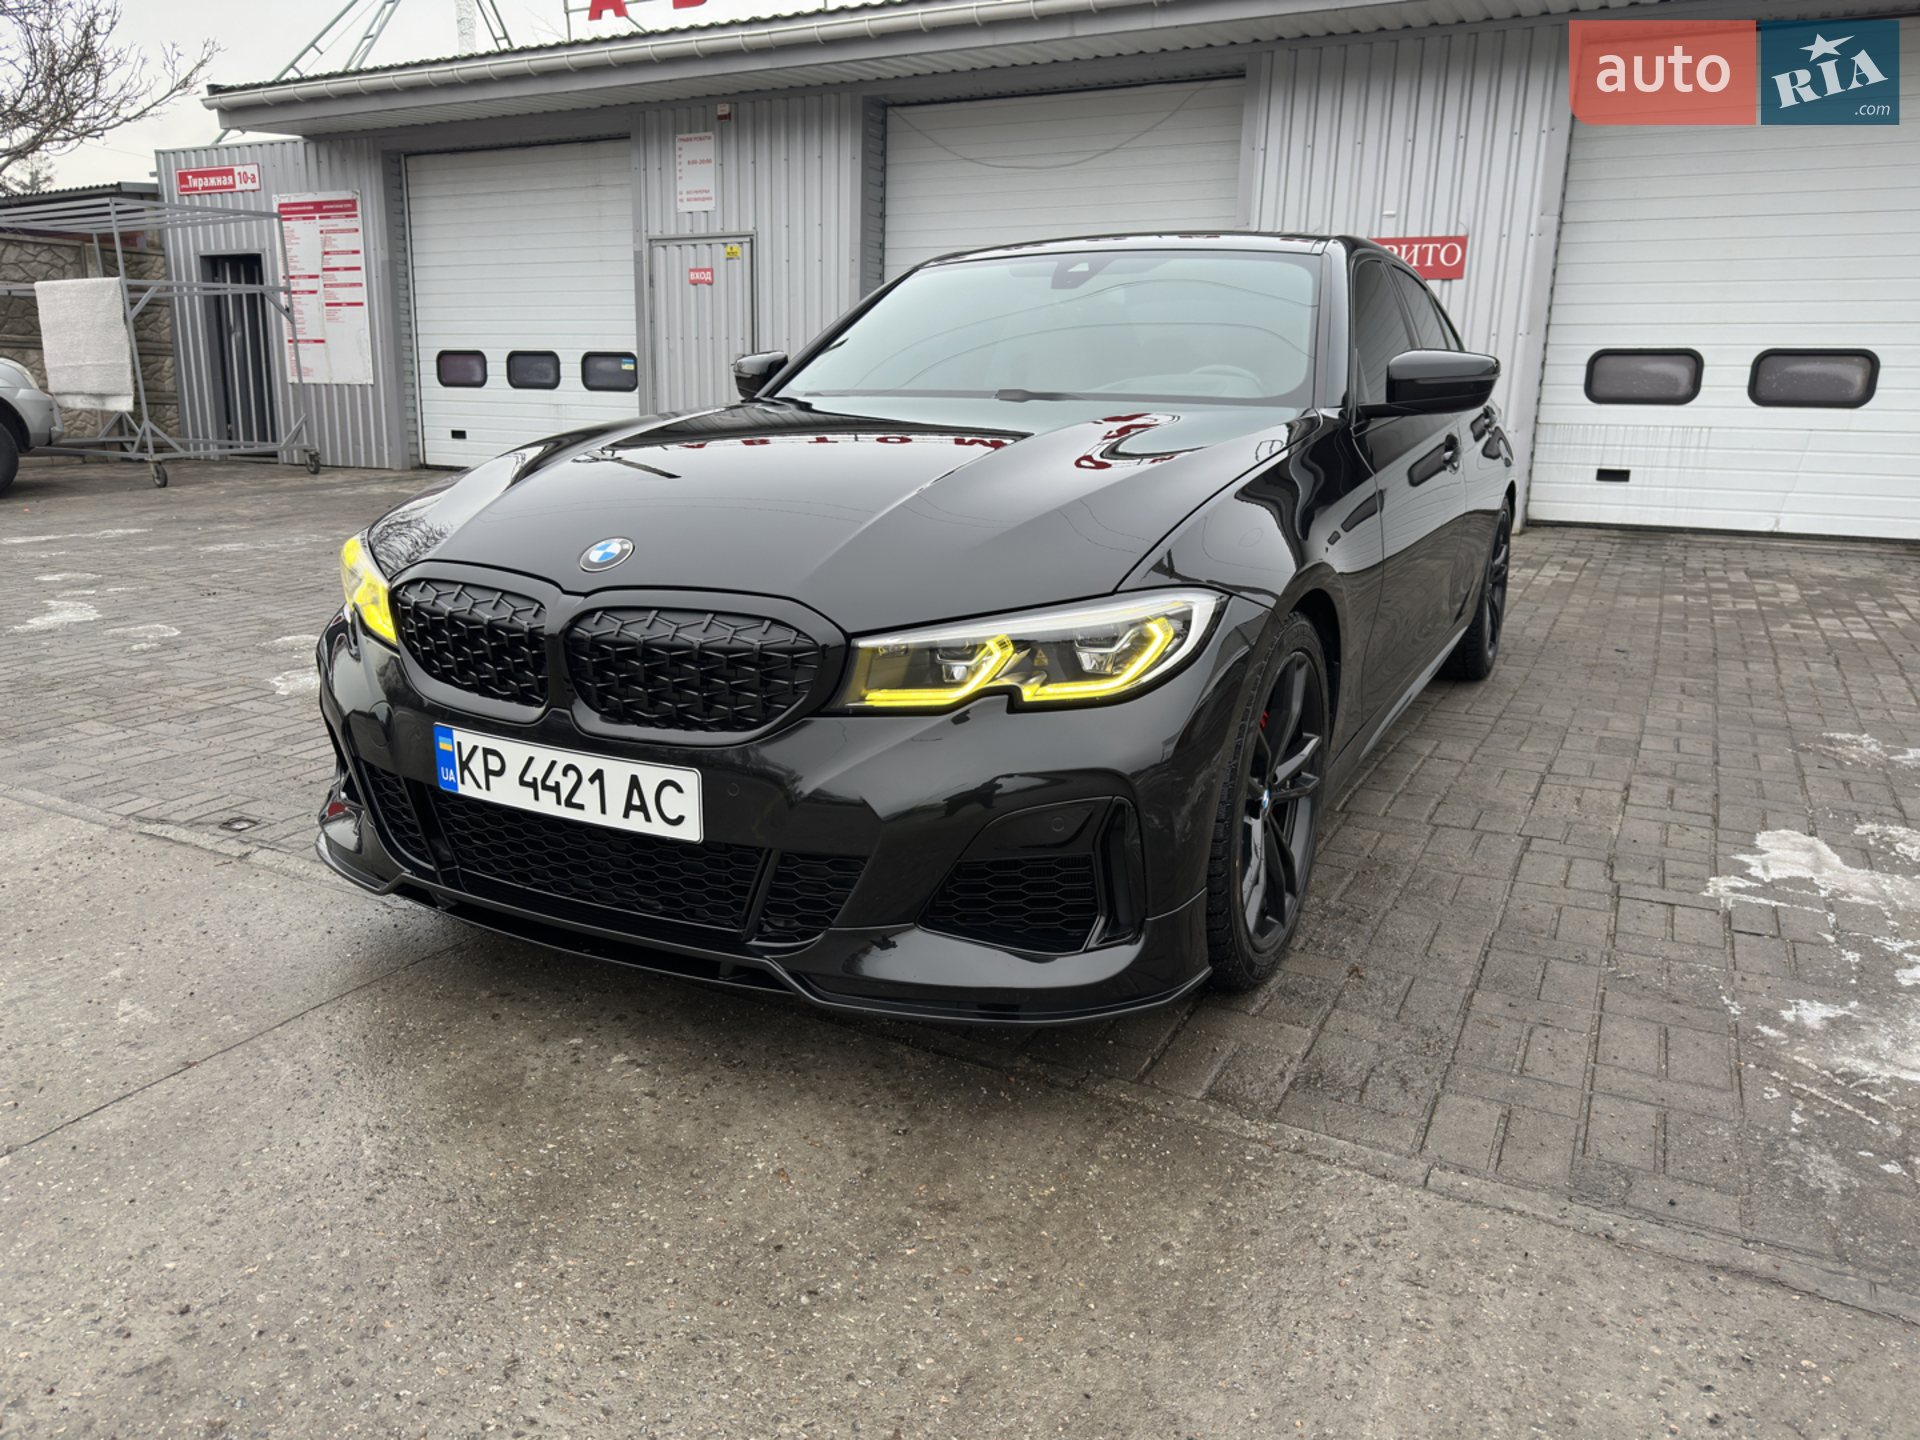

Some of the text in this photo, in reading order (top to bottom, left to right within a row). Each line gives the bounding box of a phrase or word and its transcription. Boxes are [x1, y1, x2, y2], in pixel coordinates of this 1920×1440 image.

[187, 171, 257, 190] Тиражная 10-а
[690, 271, 712, 282] ВХОД
[441, 766, 456, 782] UA
[457, 741, 685, 826] KP 4421 AC
